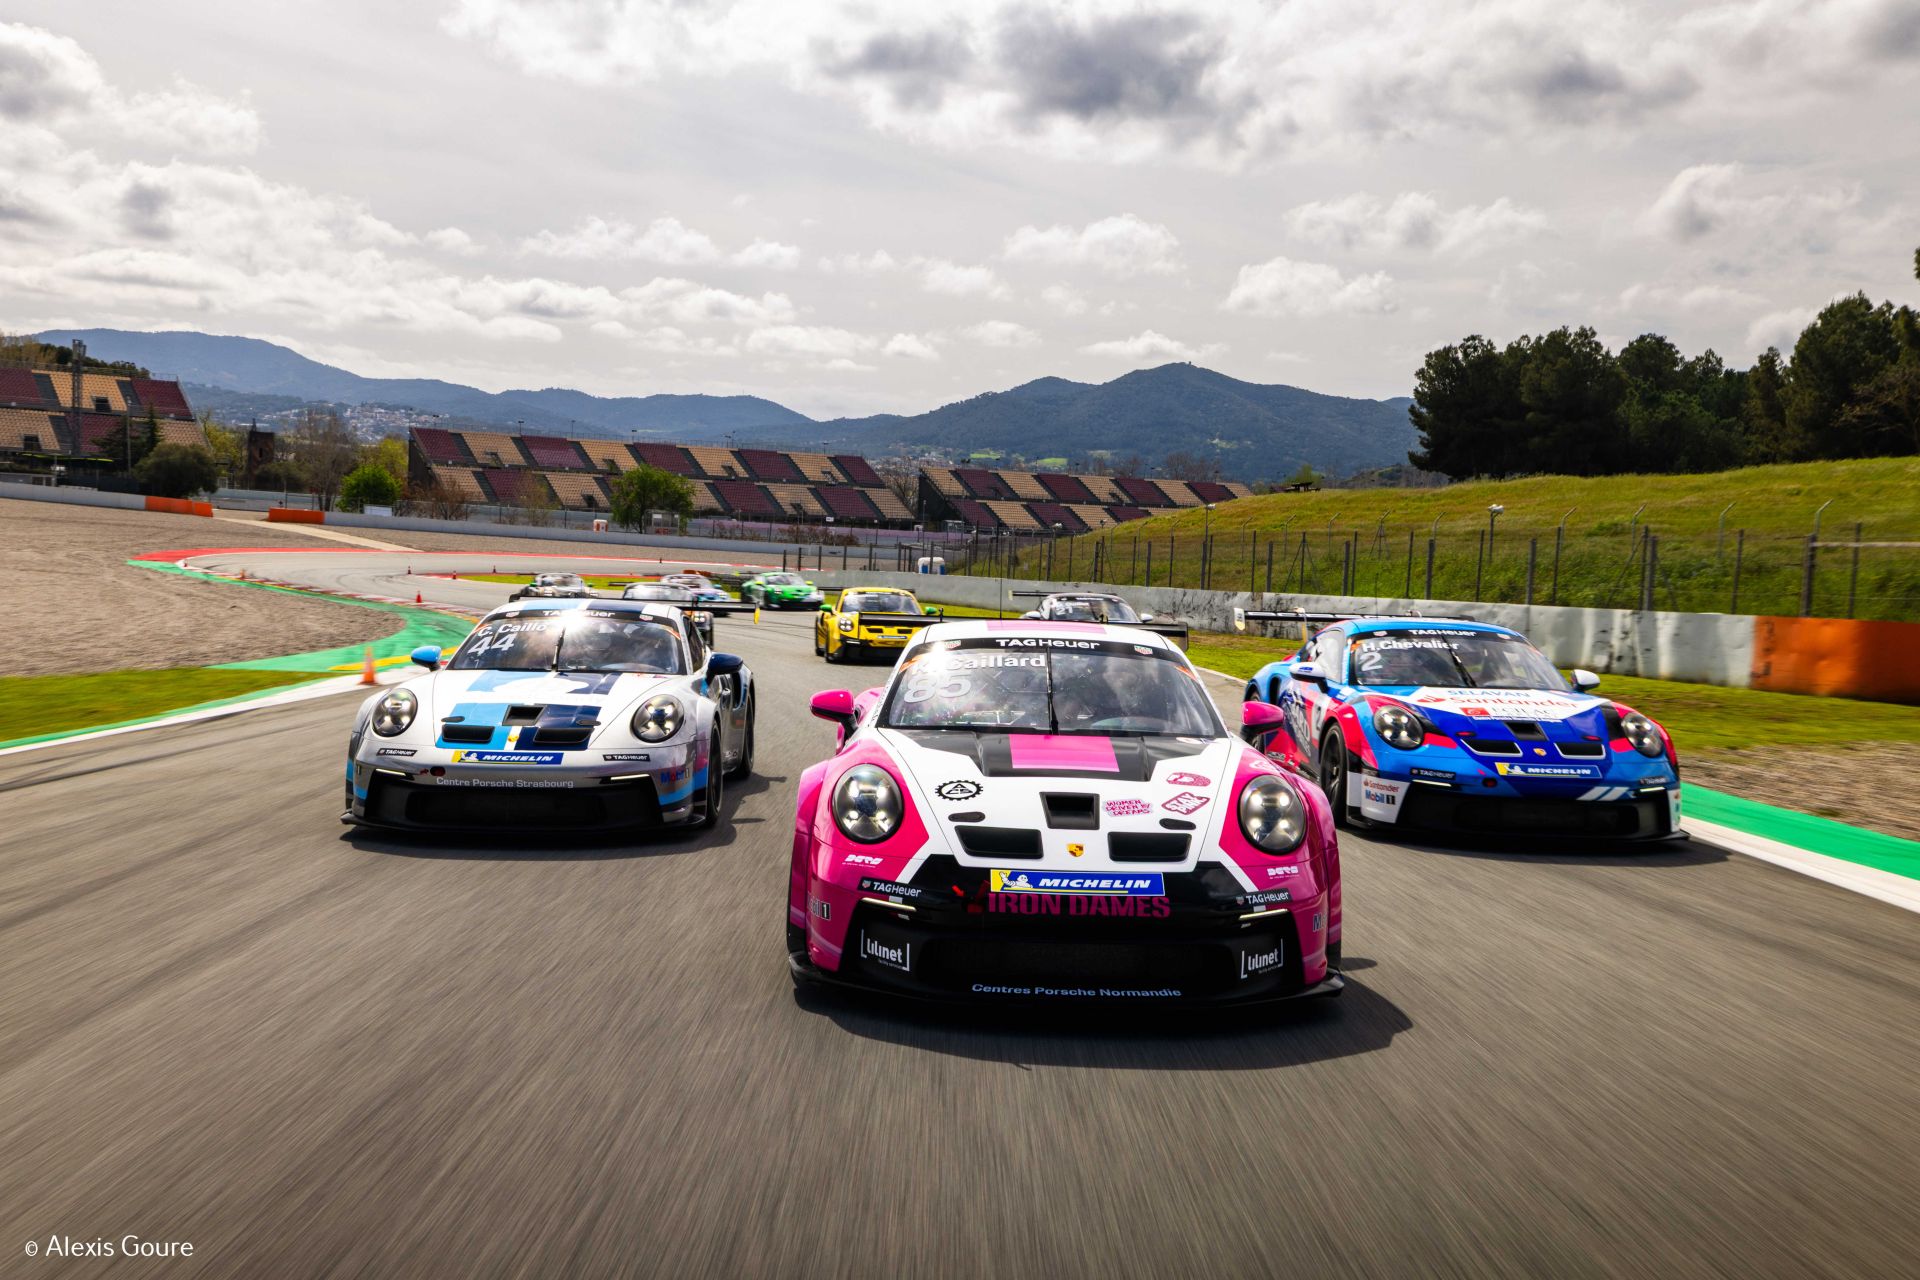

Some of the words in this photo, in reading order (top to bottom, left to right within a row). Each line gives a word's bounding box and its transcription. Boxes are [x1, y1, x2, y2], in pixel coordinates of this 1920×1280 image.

[467, 632, 517, 656] 44
[996, 638, 1100, 650] TAGHeuer
[1360, 652, 1383, 671] 2
[904, 674, 972, 703] 85
[1450, 697, 1577, 708] Santander
[482, 754, 554, 762] MICHELIN
[1527, 767, 1592, 775] MICHELIN
[436, 776, 470, 787] Centre
[472, 778, 513, 788] Porsche
[516, 778, 574, 790] Strasbourg
[1365, 789, 1385, 804] Mobil
[873, 881, 922, 897] TAGHeuer
[1038, 878, 1151, 889] MICHELIN
[987, 892, 1061, 916] IRON
[1068, 894, 1171, 918] DAMES
[1246, 891, 1289, 905] TAGHeuer
[971, 983, 1031, 994] Centres
[1034, 986, 1096, 996] Porsche
[1100, 988, 1182, 997] Normandie
